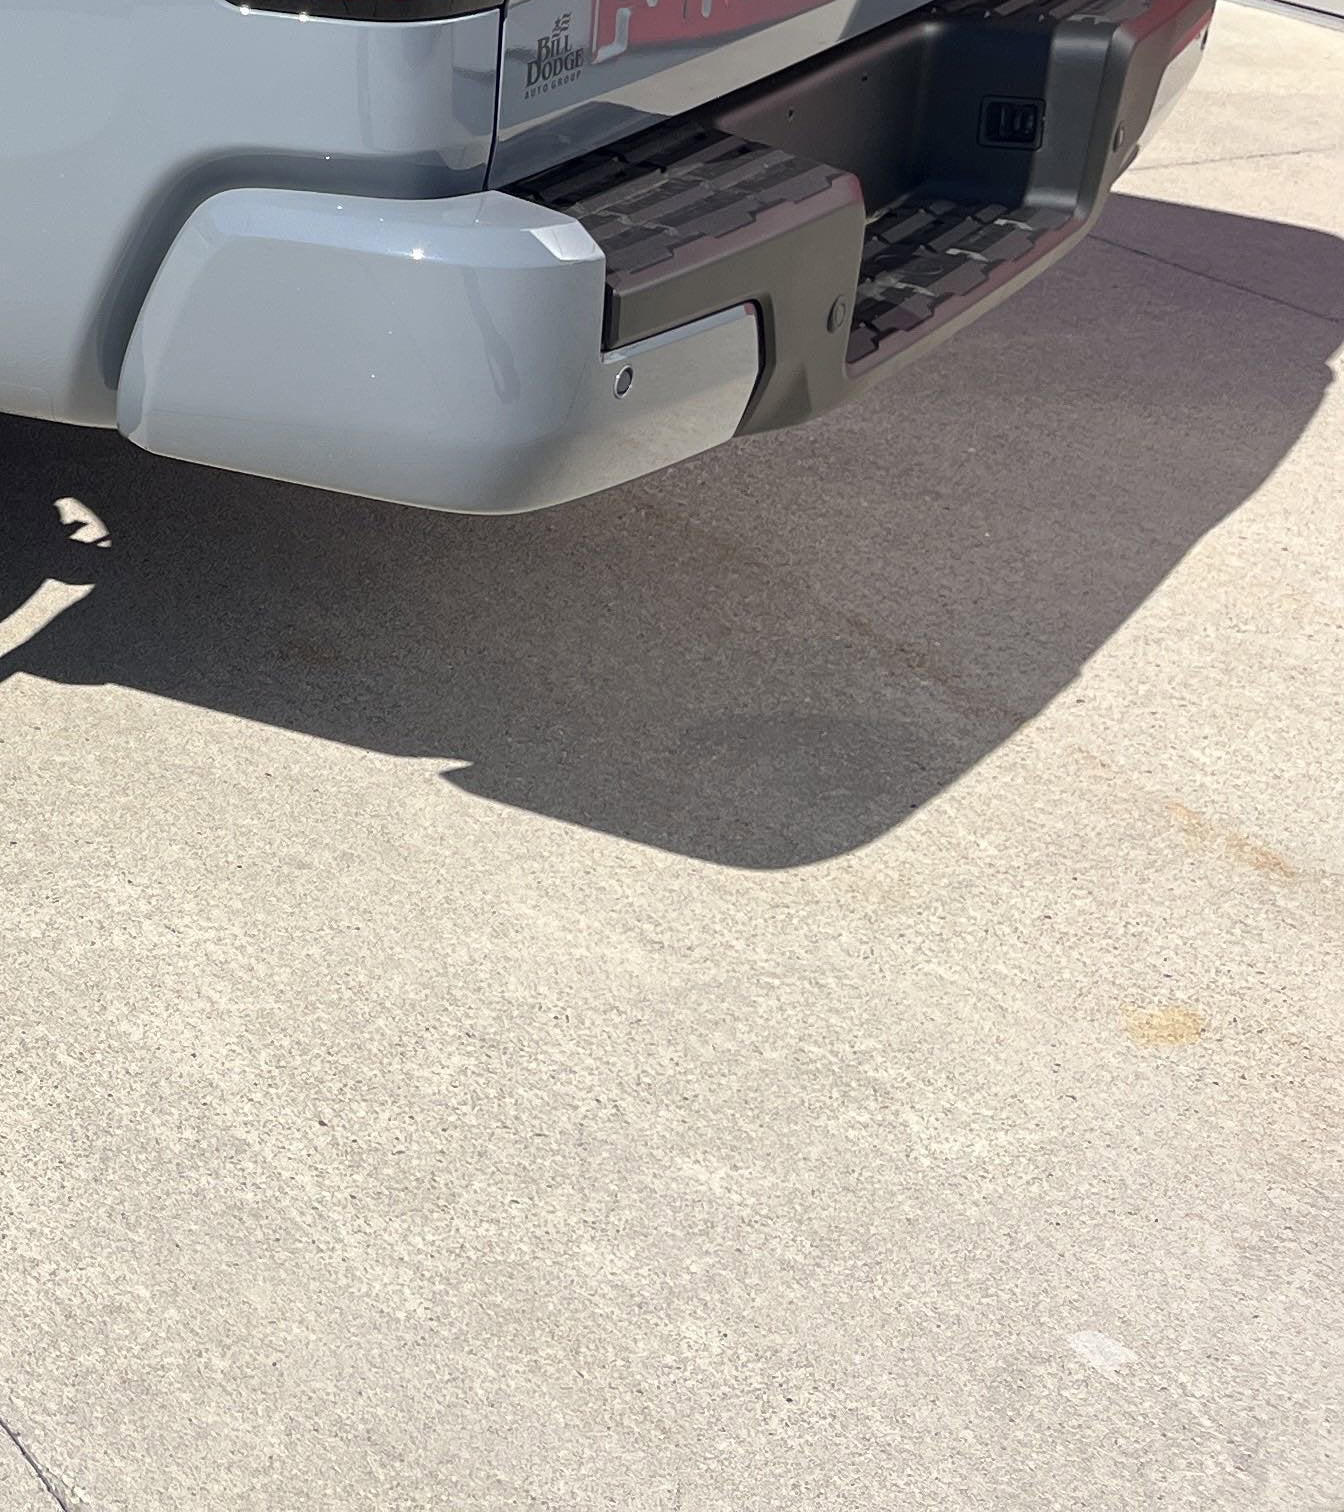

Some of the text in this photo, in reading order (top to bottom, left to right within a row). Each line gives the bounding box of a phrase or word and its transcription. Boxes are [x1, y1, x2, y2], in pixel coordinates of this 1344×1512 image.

[537, 34, 573, 61] BILL
[526, 47, 584, 88] DODGE
[524, 69, 582, 100] AUTO GROUP
